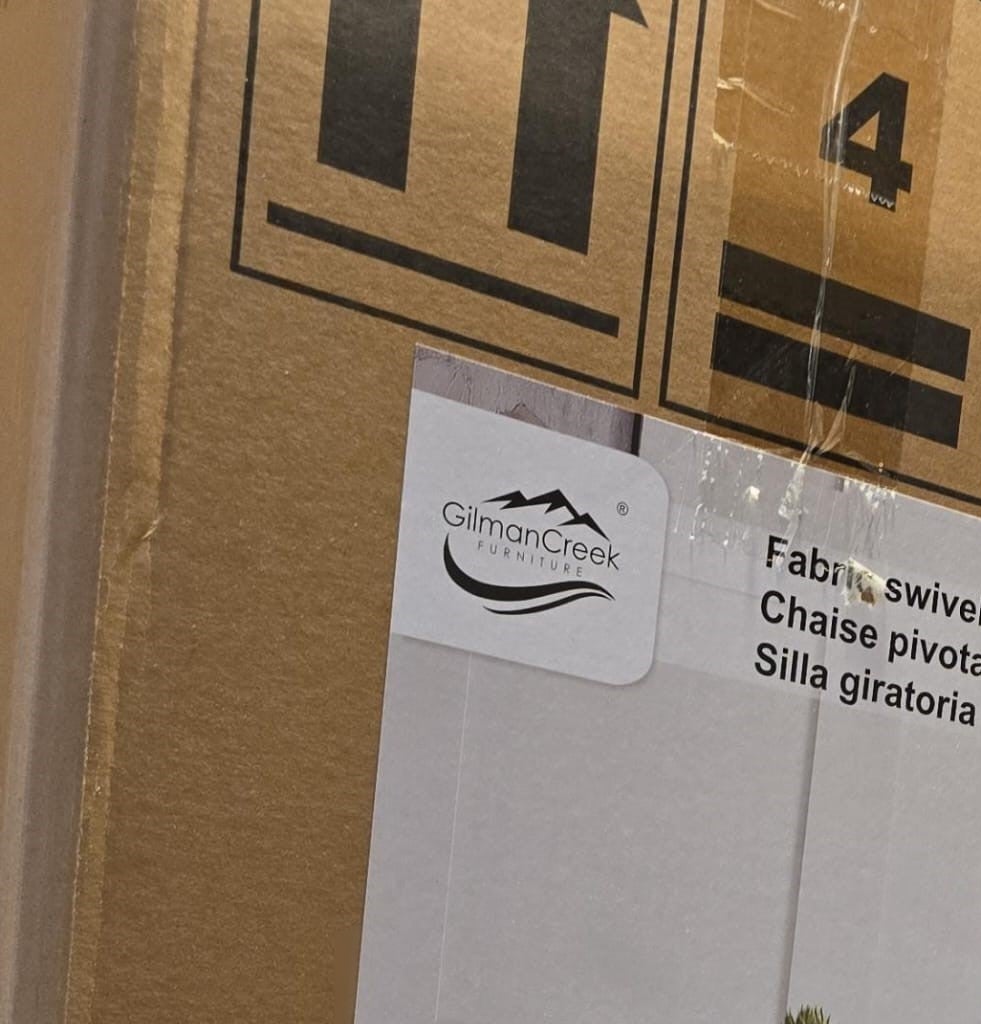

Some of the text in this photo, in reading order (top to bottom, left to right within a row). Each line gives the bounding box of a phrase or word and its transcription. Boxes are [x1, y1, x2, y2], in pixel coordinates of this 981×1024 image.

[820, 72, 913, 213] 4
[442, 501, 621, 570] GilmanCreek
[477, 540, 583, 577] FURNITURE
[761, 590, 878, 648] Chaise
[754, 642, 828, 690] Silla
[840, 669, 976, 726] giratoria
